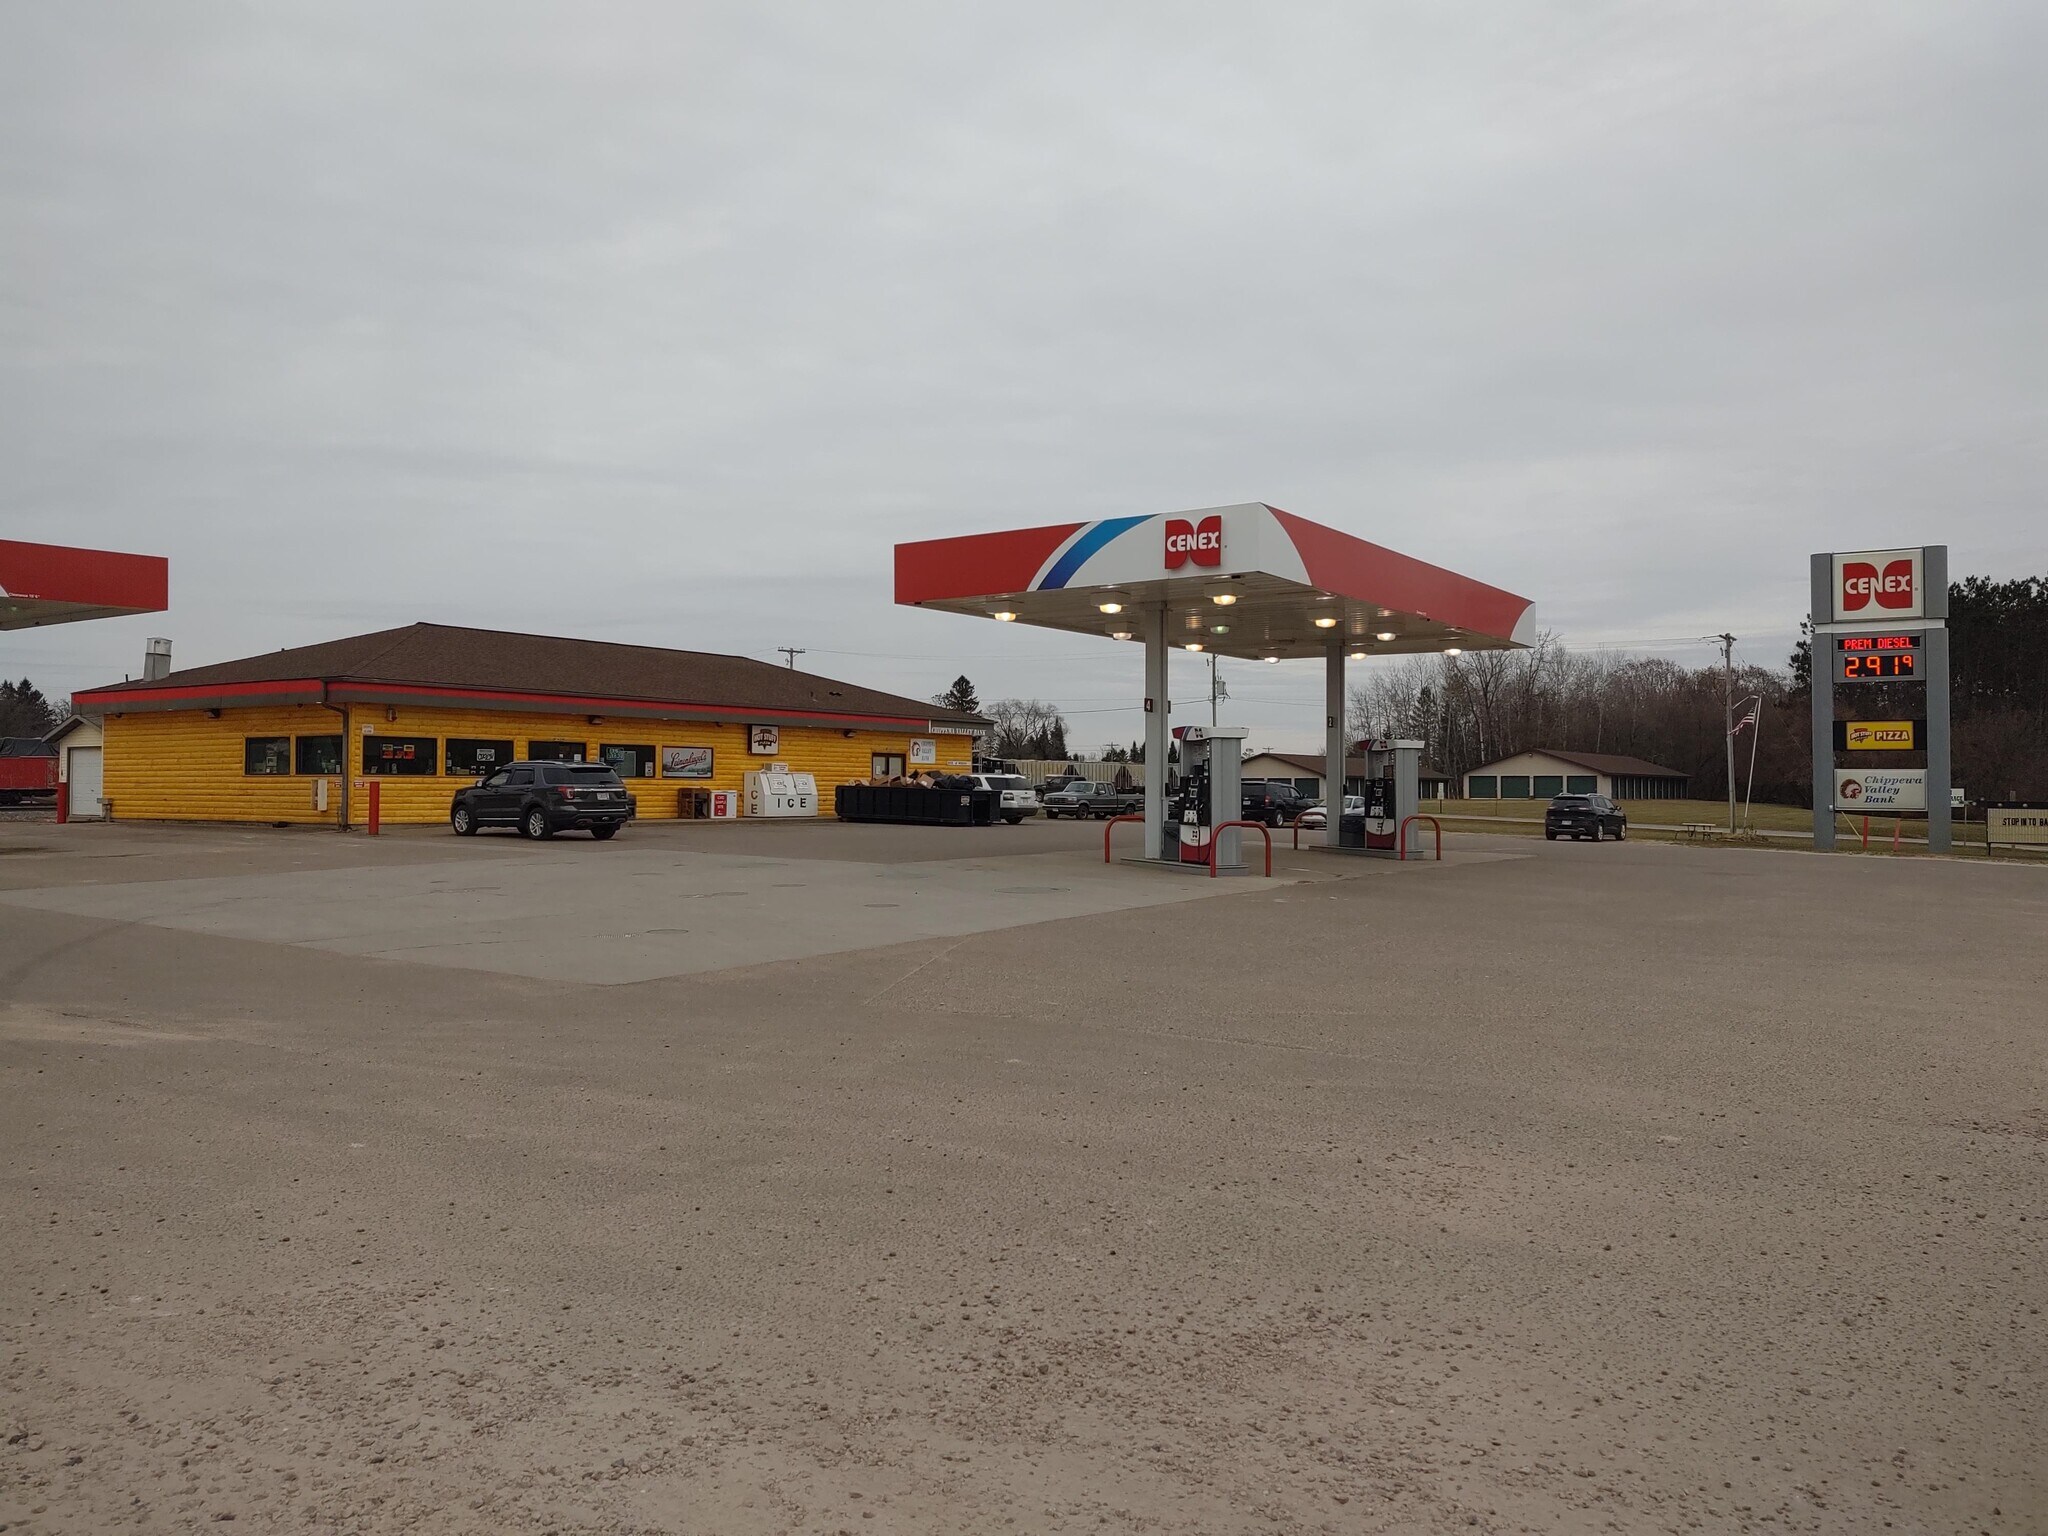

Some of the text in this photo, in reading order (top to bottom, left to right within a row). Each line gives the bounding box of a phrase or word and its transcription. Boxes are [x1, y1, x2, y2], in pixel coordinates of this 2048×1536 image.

[1166, 531, 1219, 552] CENEX
[1844, 574, 1911, 595] CENEX
[1844, 637, 1913, 650] PREM DIESEL
[1876, 731, 1909, 740] PIZZA
[1864, 775, 1923, 785] Chippewa
[1864, 785, 1901, 795] Valley
[777, 797, 807, 808] ICE
[1864, 795, 1896, 804] Bank
[2002, 818, 2019, 826] STOP
[2020, 818, 2027, 826] IN
[2028, 818, 2037, 826] TO
